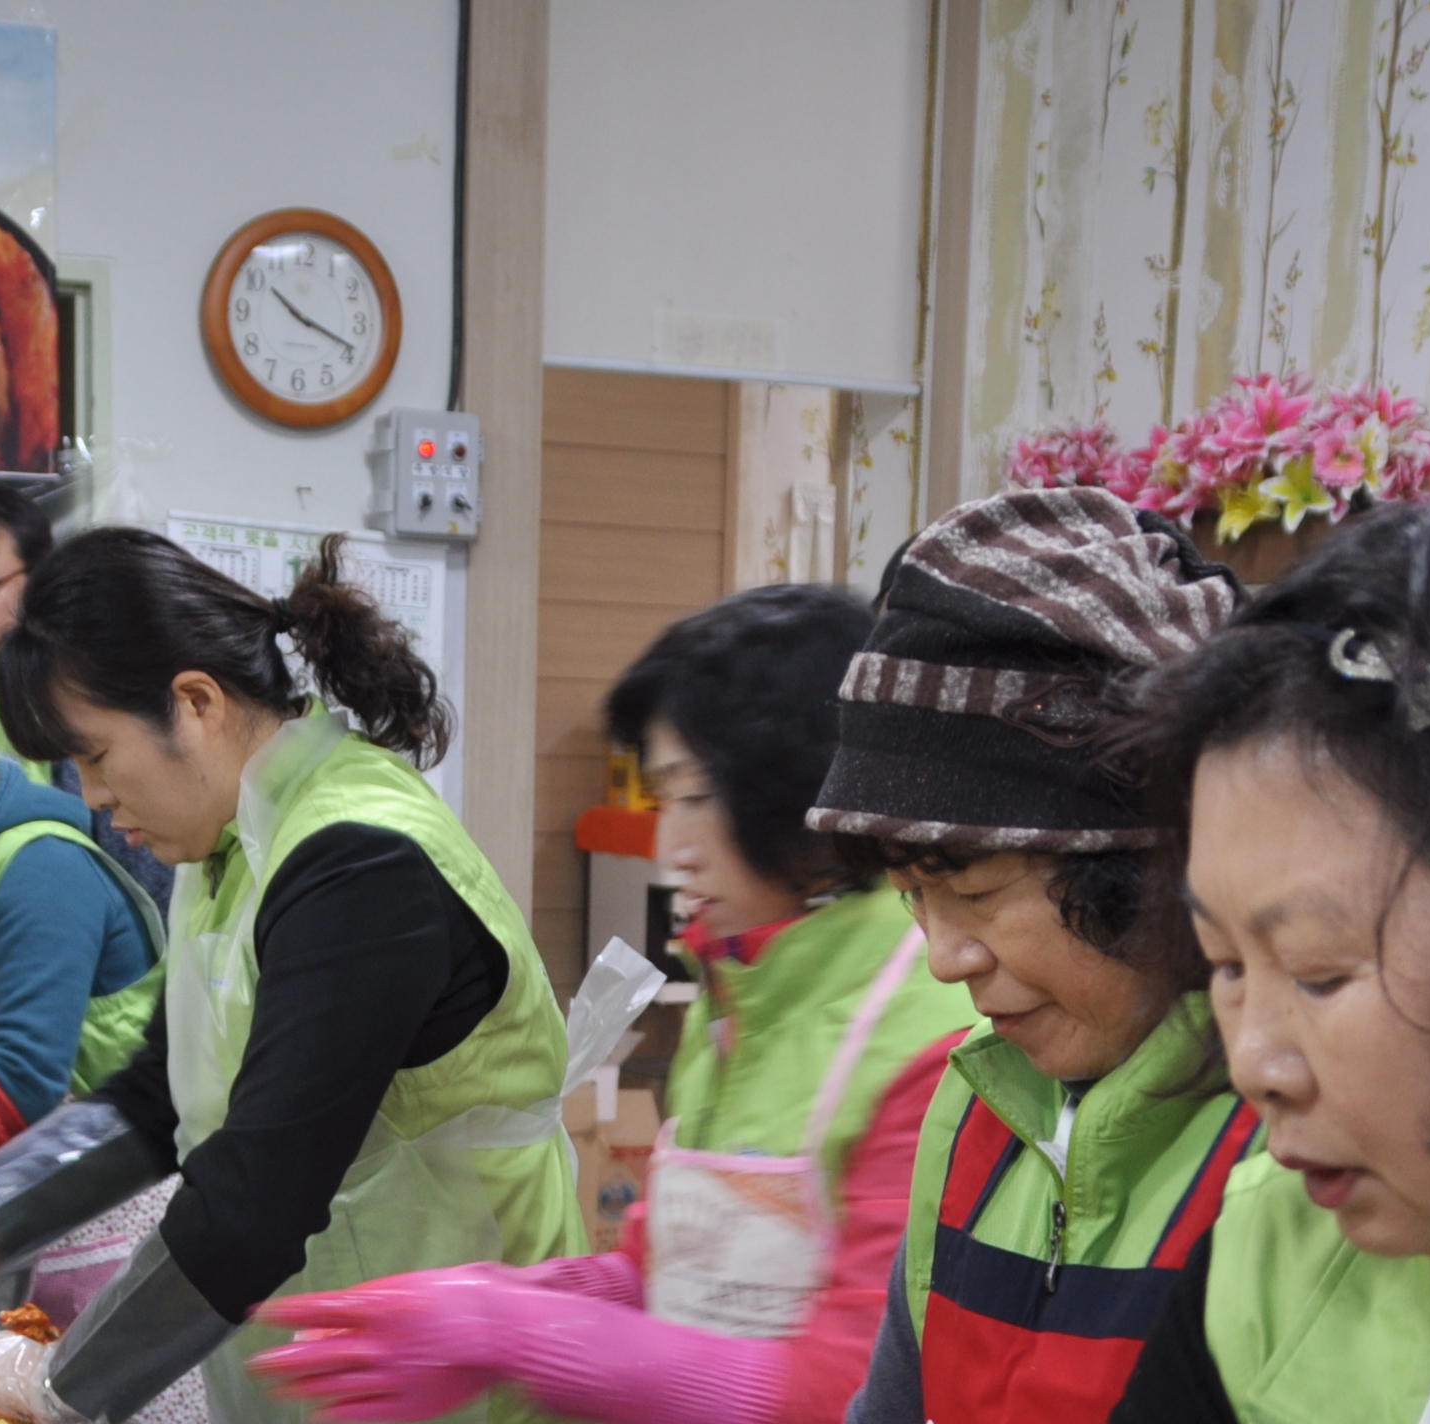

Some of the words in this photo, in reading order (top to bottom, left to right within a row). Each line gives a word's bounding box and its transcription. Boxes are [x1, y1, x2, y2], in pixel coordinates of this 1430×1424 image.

[244, 267, 266, 291] 10
[344, 277, 360, 300] 2
[235, 298, 251, 322] 9
[352, 312, 367, 335] 3
[243, 332, 260, 356] 8
[264, 358, 277, 381] 7
[289, 368, 306, 392] 6
[320, 363, 335, 386] 5
